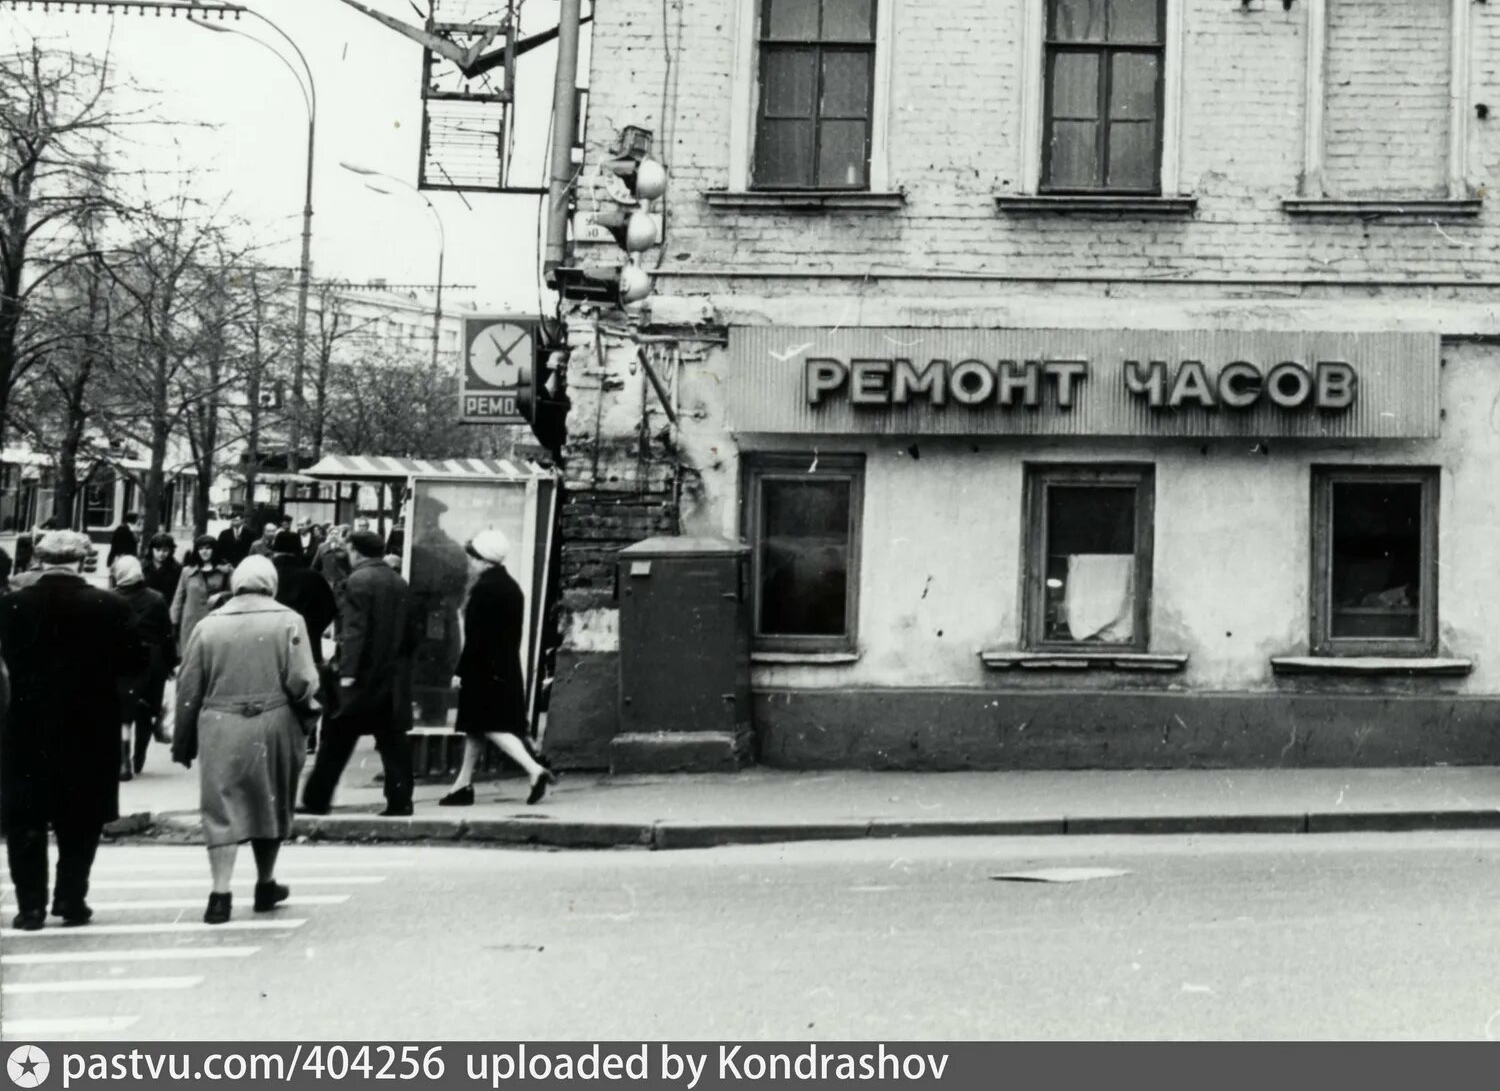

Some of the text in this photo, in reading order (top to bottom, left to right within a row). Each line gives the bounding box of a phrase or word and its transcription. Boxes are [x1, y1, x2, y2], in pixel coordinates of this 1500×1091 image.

[804, 357, 1358, 411] РЕМОНТ ЧАСОВ
[466, 397, 520, 415] РЕМО
